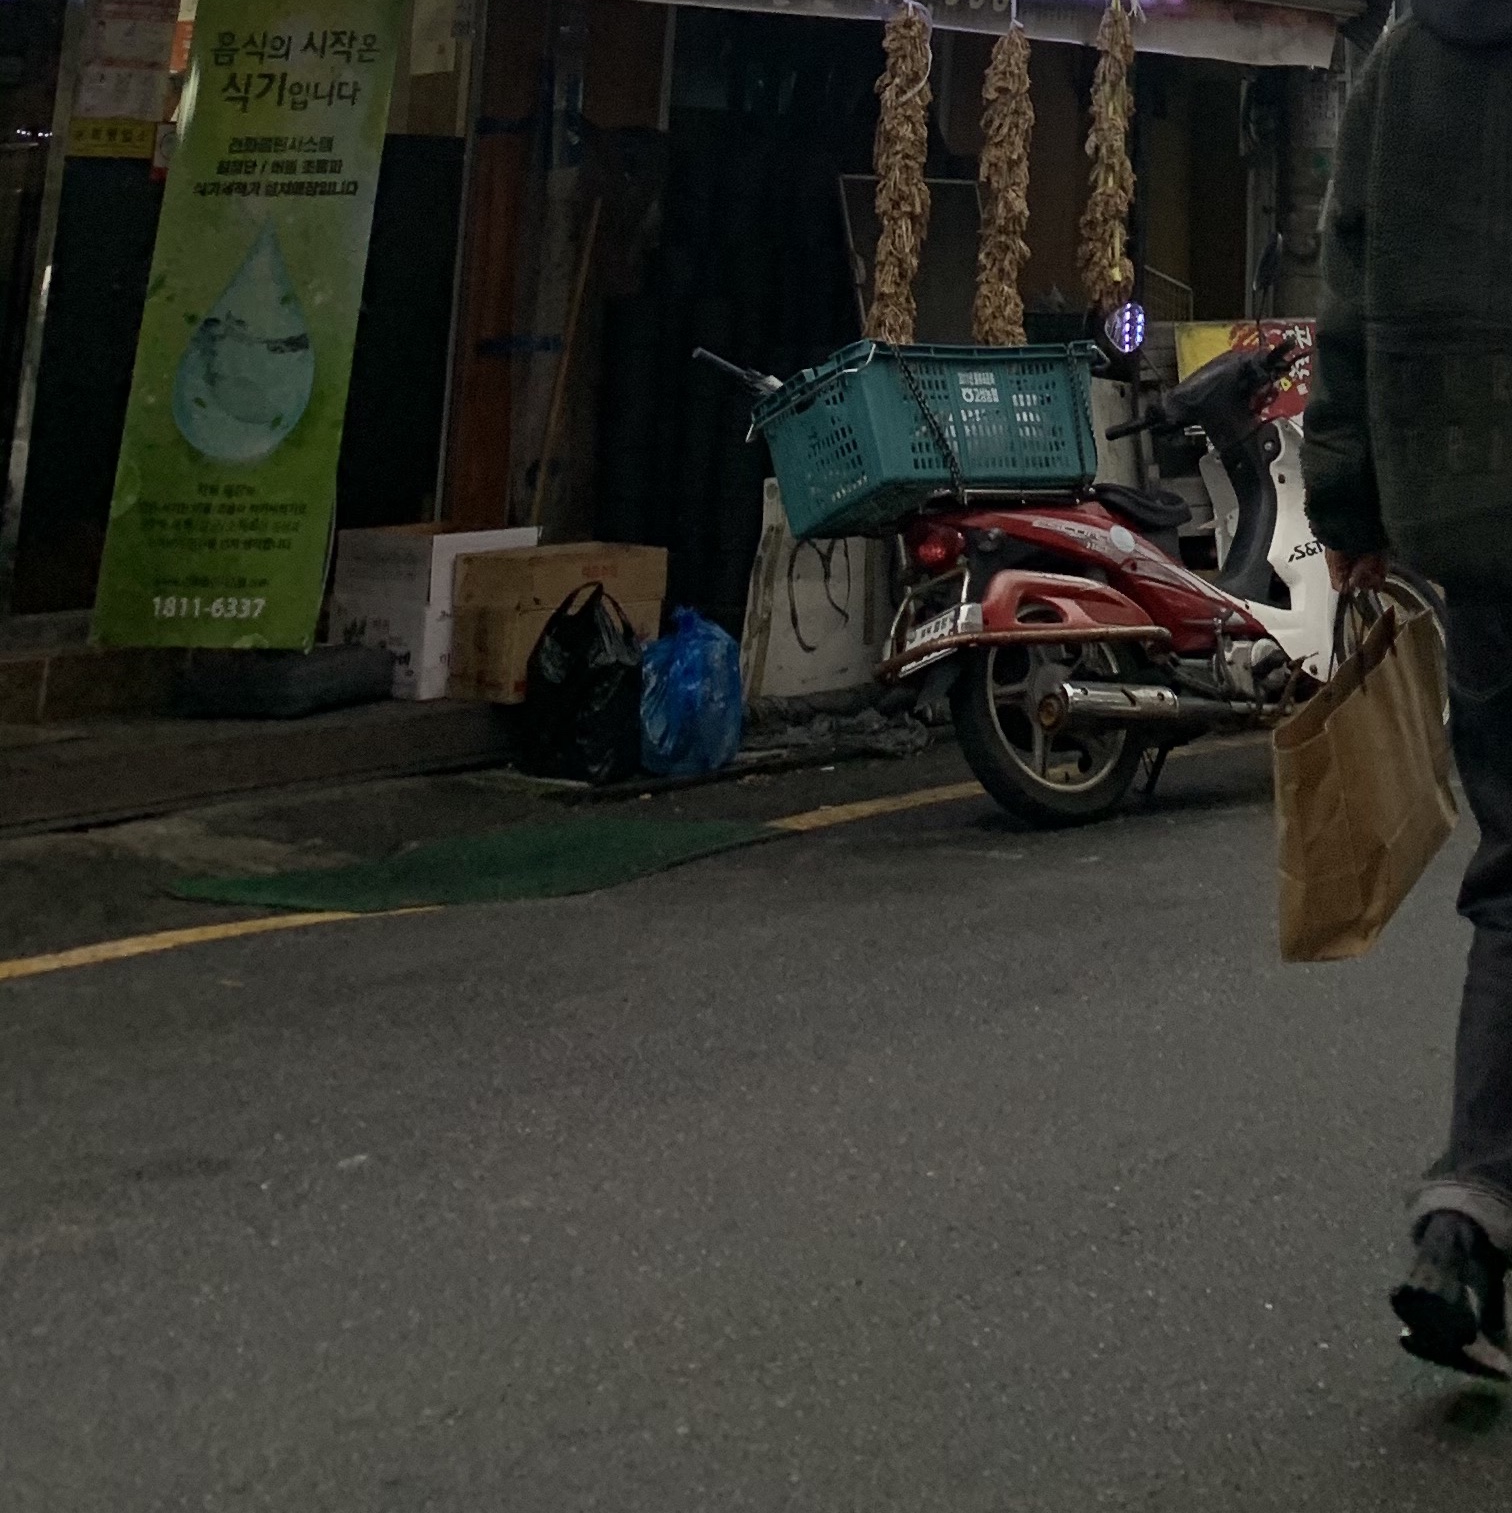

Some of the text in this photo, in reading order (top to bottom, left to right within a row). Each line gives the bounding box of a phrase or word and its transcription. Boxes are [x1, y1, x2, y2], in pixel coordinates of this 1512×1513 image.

[210, 30, 381, 66] 음식의 시작은
[222, 72, 361, 113] 식기입니다
[1294, 541, 1323, 560] S&T
[153, 596, 267, 619] 1811-6337
